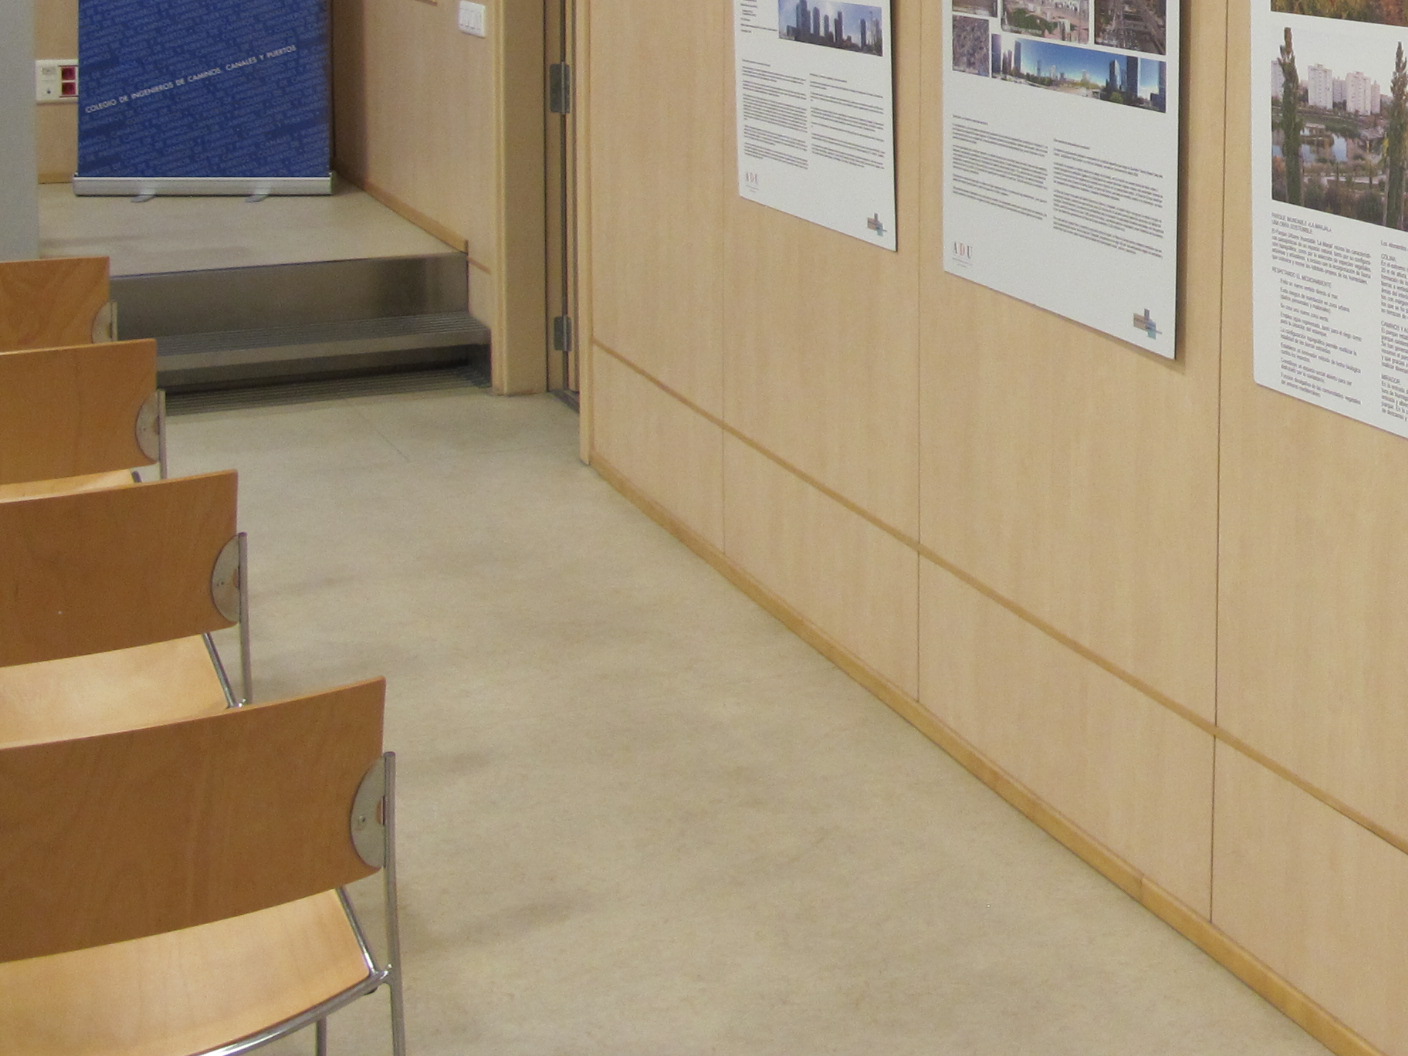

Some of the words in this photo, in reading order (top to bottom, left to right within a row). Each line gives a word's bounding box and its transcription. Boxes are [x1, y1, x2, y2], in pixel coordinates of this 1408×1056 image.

[85, 99, 116, 113] COLEGIO
[119, 95, 129, 103] DE
[132, 82, 173, 99] INGENIEROS
[175, 78, 185, 86] DE
[226, 57, 257, 71] CANALES
[266, 45, 297, 58] PUERTOS
